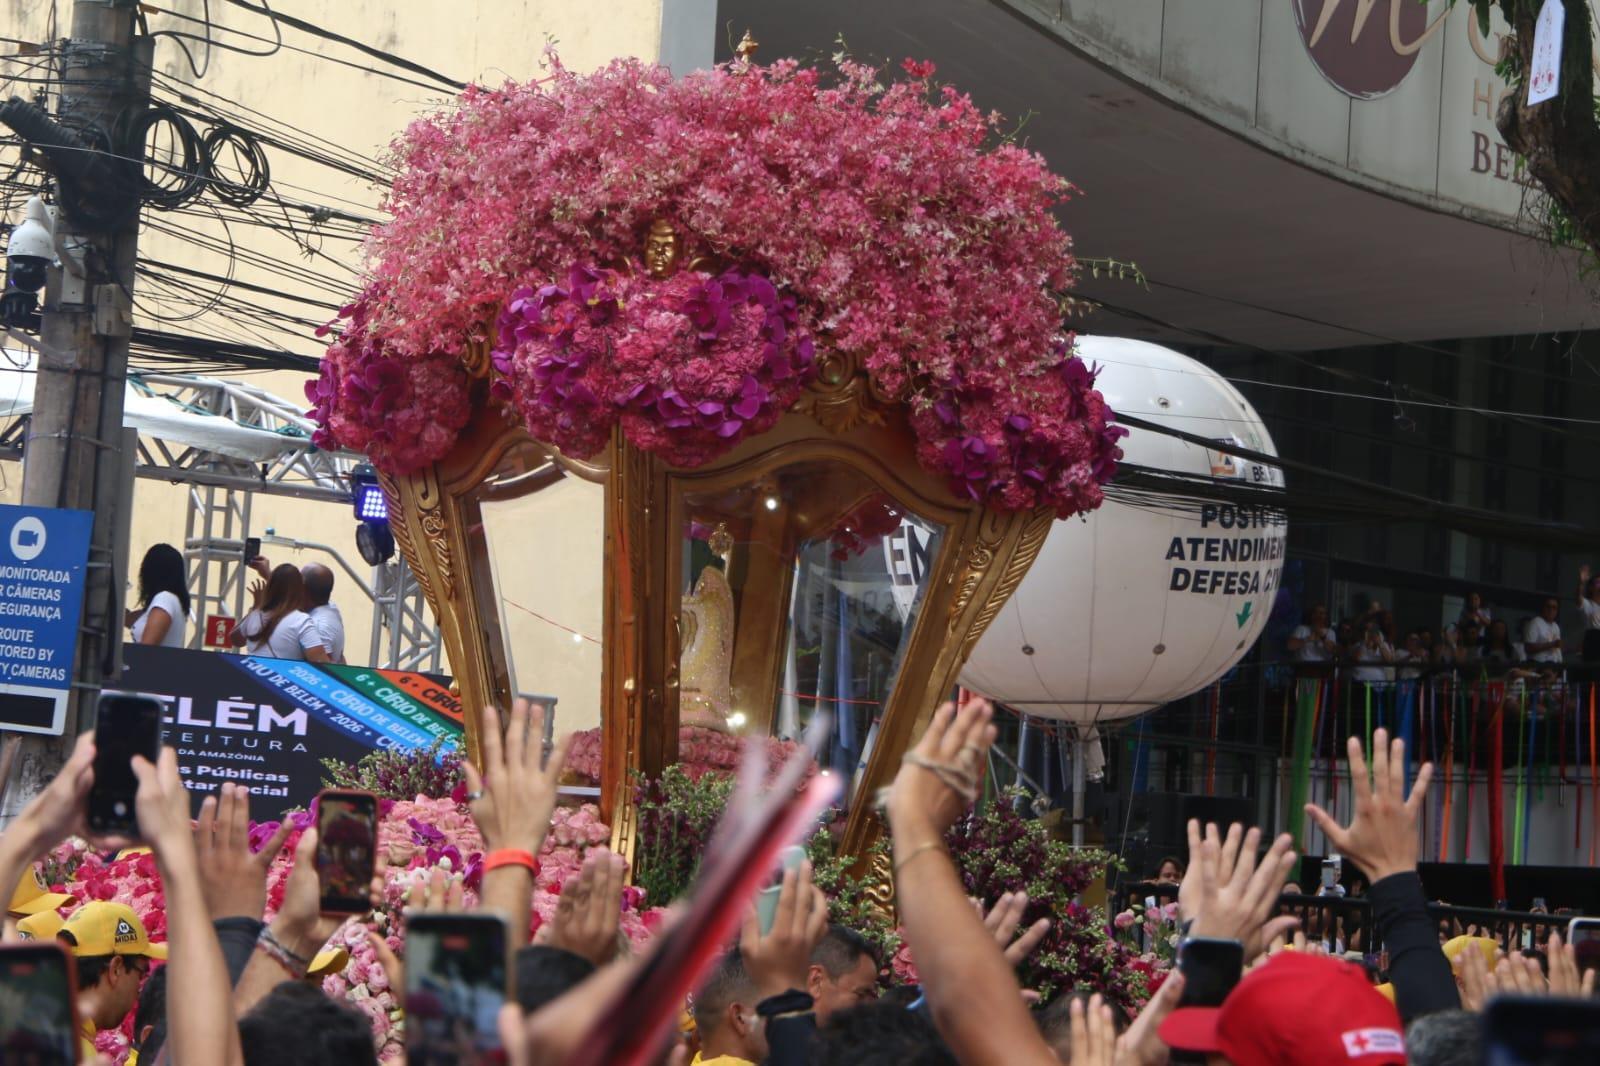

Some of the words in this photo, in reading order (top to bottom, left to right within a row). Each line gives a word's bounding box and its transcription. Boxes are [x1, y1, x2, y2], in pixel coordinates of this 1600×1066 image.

[1170, 567, 1259, 595] DEFESA
[38, 648, 55, 662] BY
[11, 663, 66, 681] CAMERAS
[287, 665, 323, 686] 2026
[267, 673, 291, 688] DE
[329, 712, 366, 734] 2026
[160, 731, 308, 753] FEITURA
[178, 748, 196, 757] DA
[197, 765, 290, 783] Públicas
